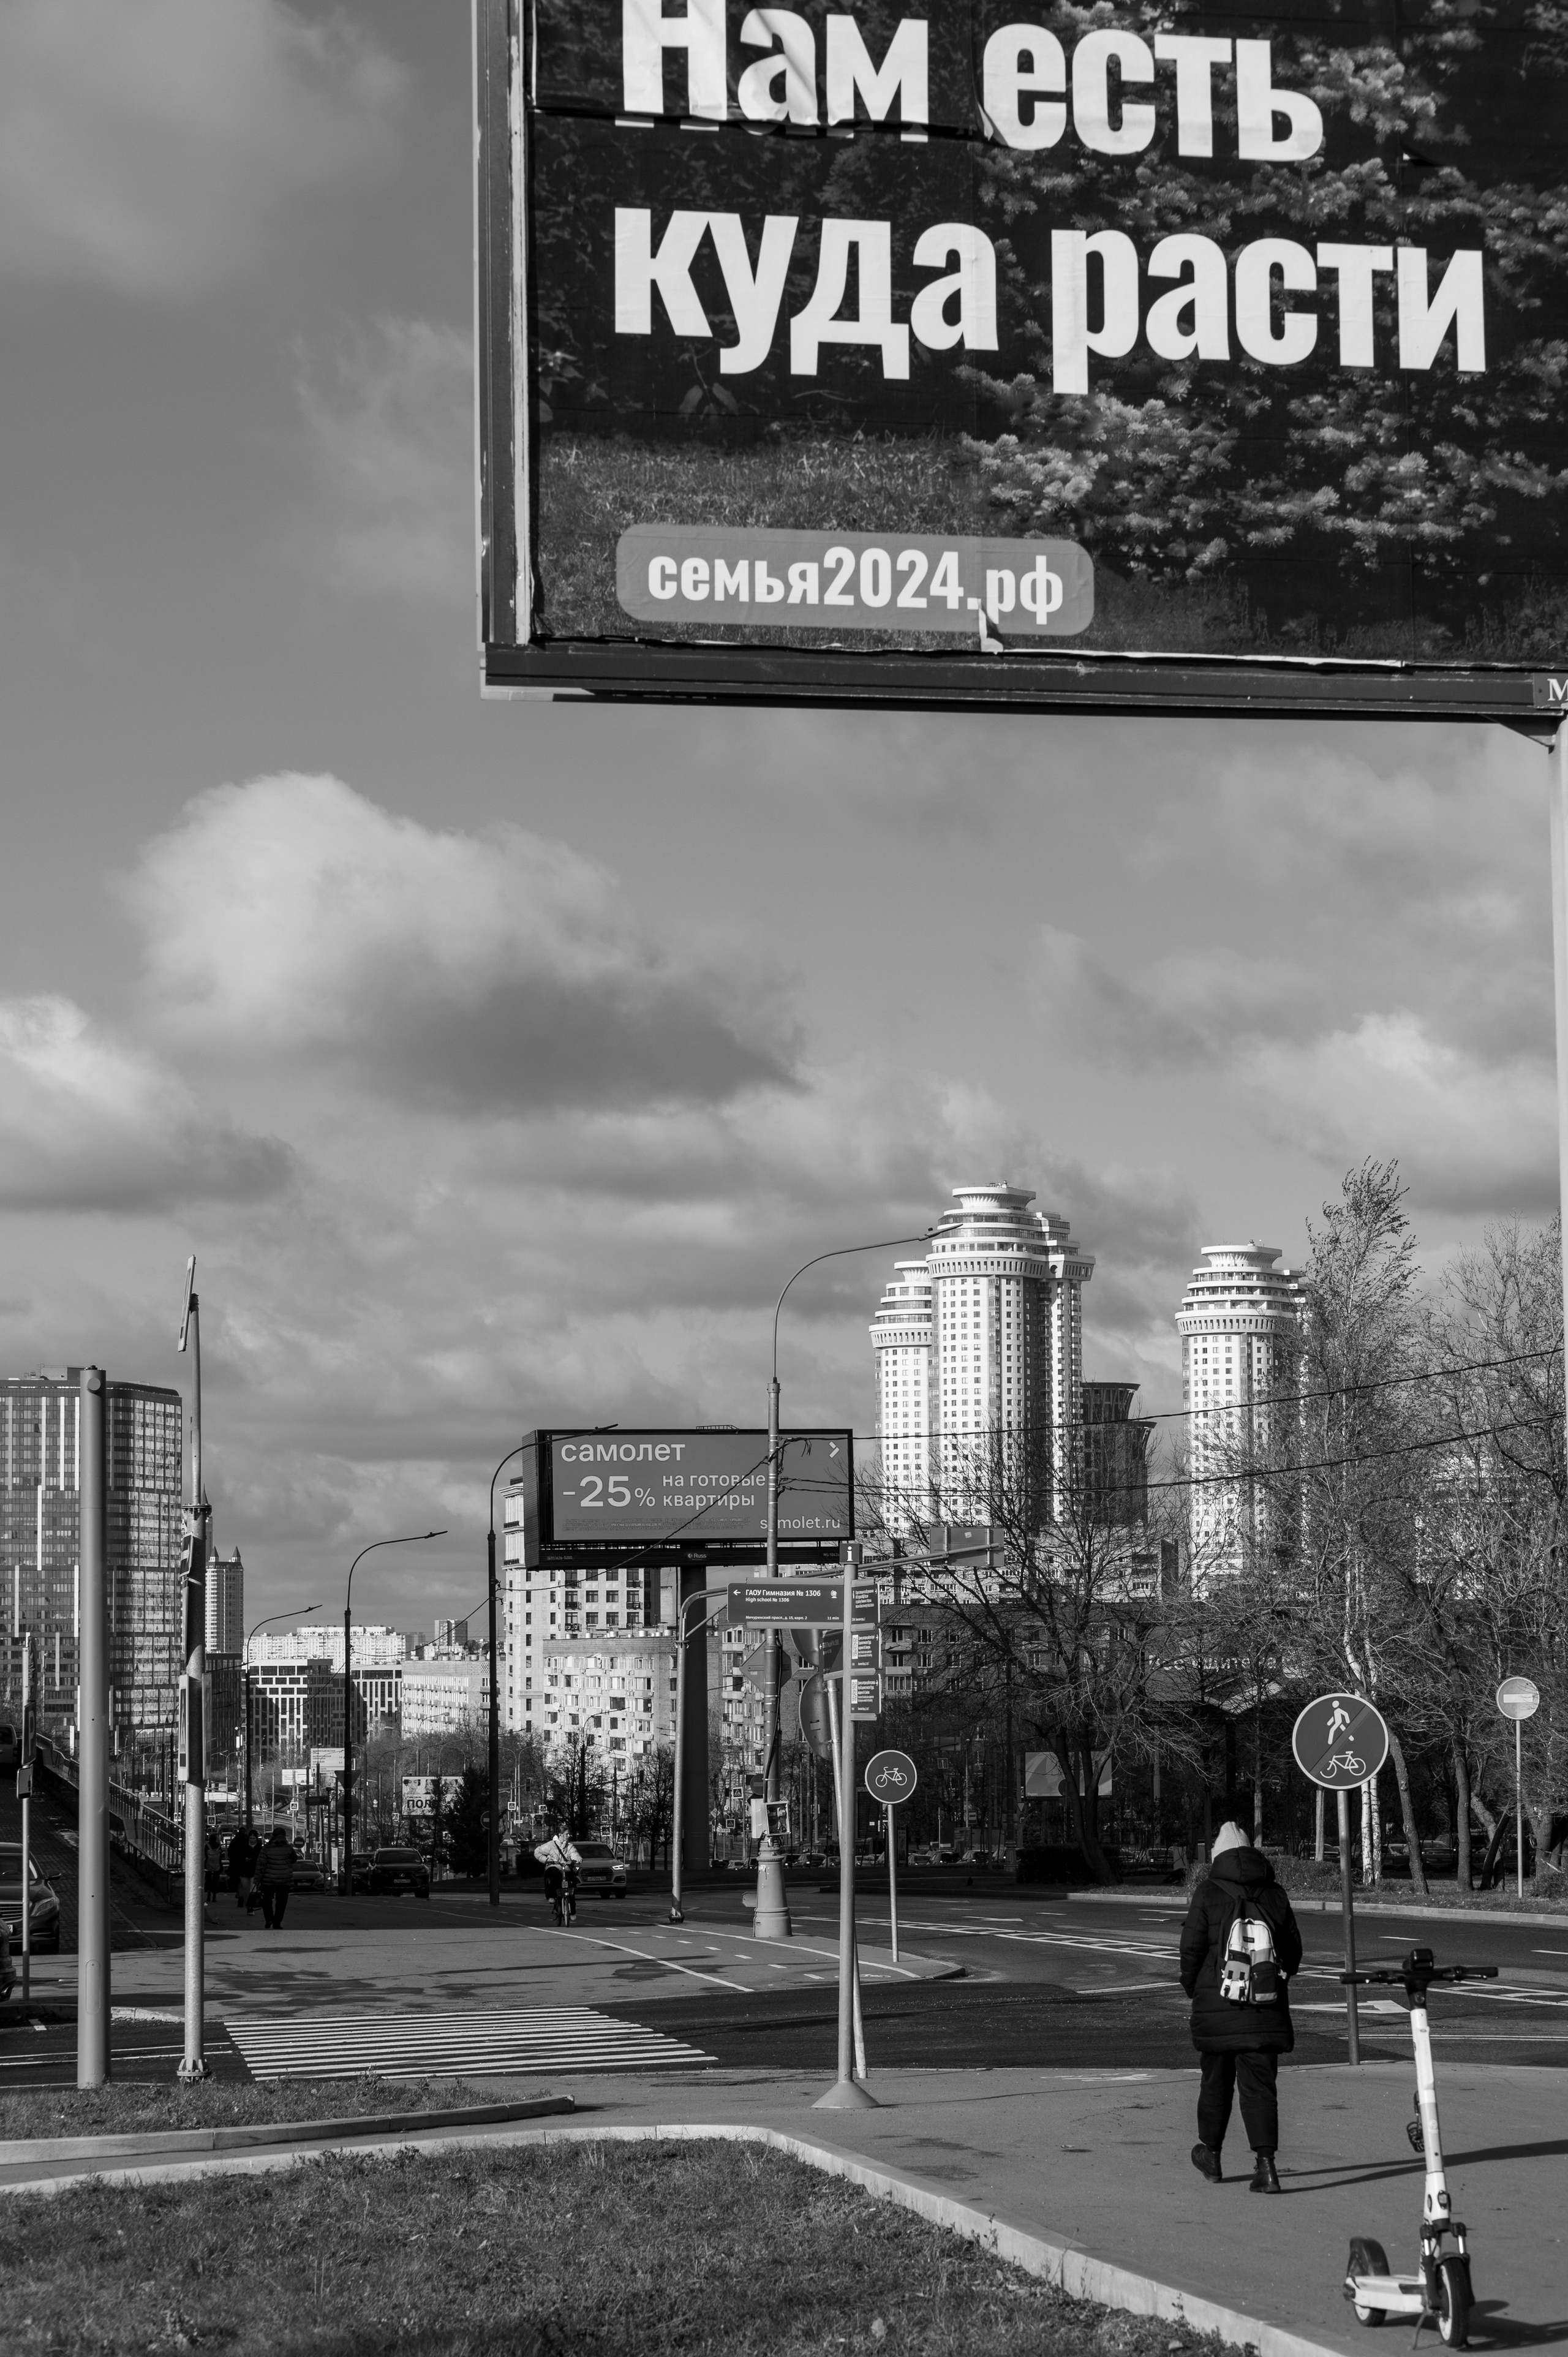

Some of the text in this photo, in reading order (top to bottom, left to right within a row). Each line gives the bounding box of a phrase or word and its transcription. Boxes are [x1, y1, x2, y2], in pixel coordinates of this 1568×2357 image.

[614, 0, 1324, 162] Нам есть
[614, 207, 1487, 395] куда расти
[648, 546, 1063, 625] семья2024.рф
[560, 1443, 686, 1462] самолет
[663, 1474, 766, 1487] на готовые
[663, 1493, 755, 1510] квартиры
[760, 1515, 841, 1529] smolet.ru
